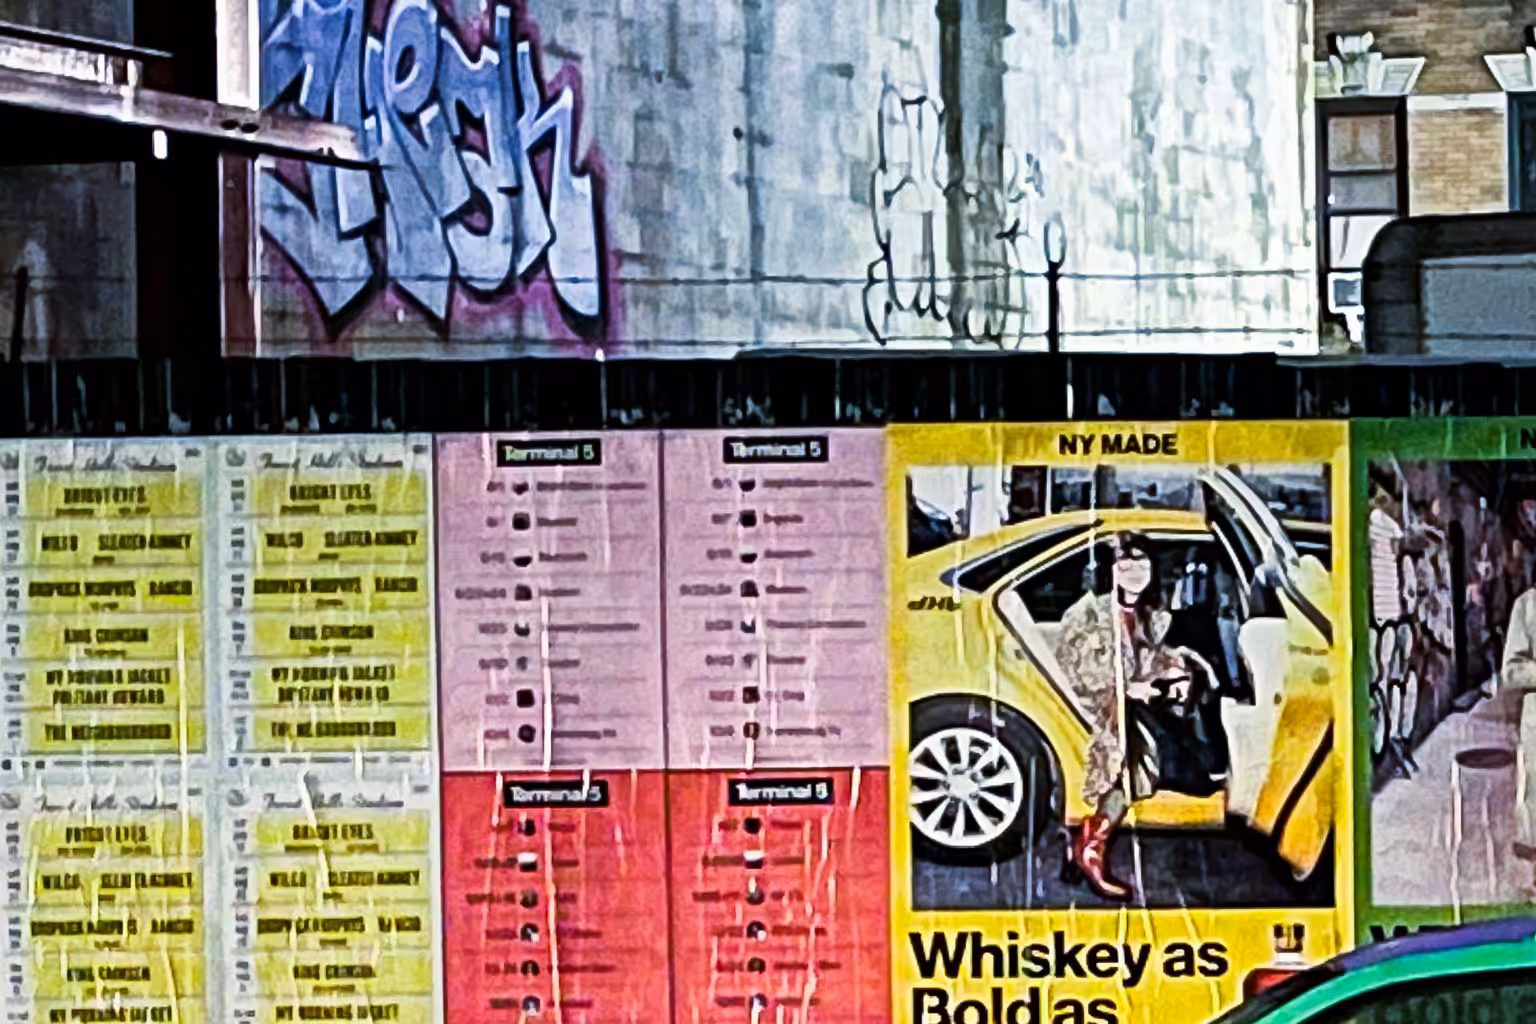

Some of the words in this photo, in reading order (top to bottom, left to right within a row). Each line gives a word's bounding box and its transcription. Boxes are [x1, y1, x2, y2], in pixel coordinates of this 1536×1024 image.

[810, 441, 821, 457] 5
[1059, 434, 1095, 455] NY
[1100, 433, 1178, 455] MADE
[909, 931, 1151, 987] Whiskey
[1162, 941, 1228, 977] as
